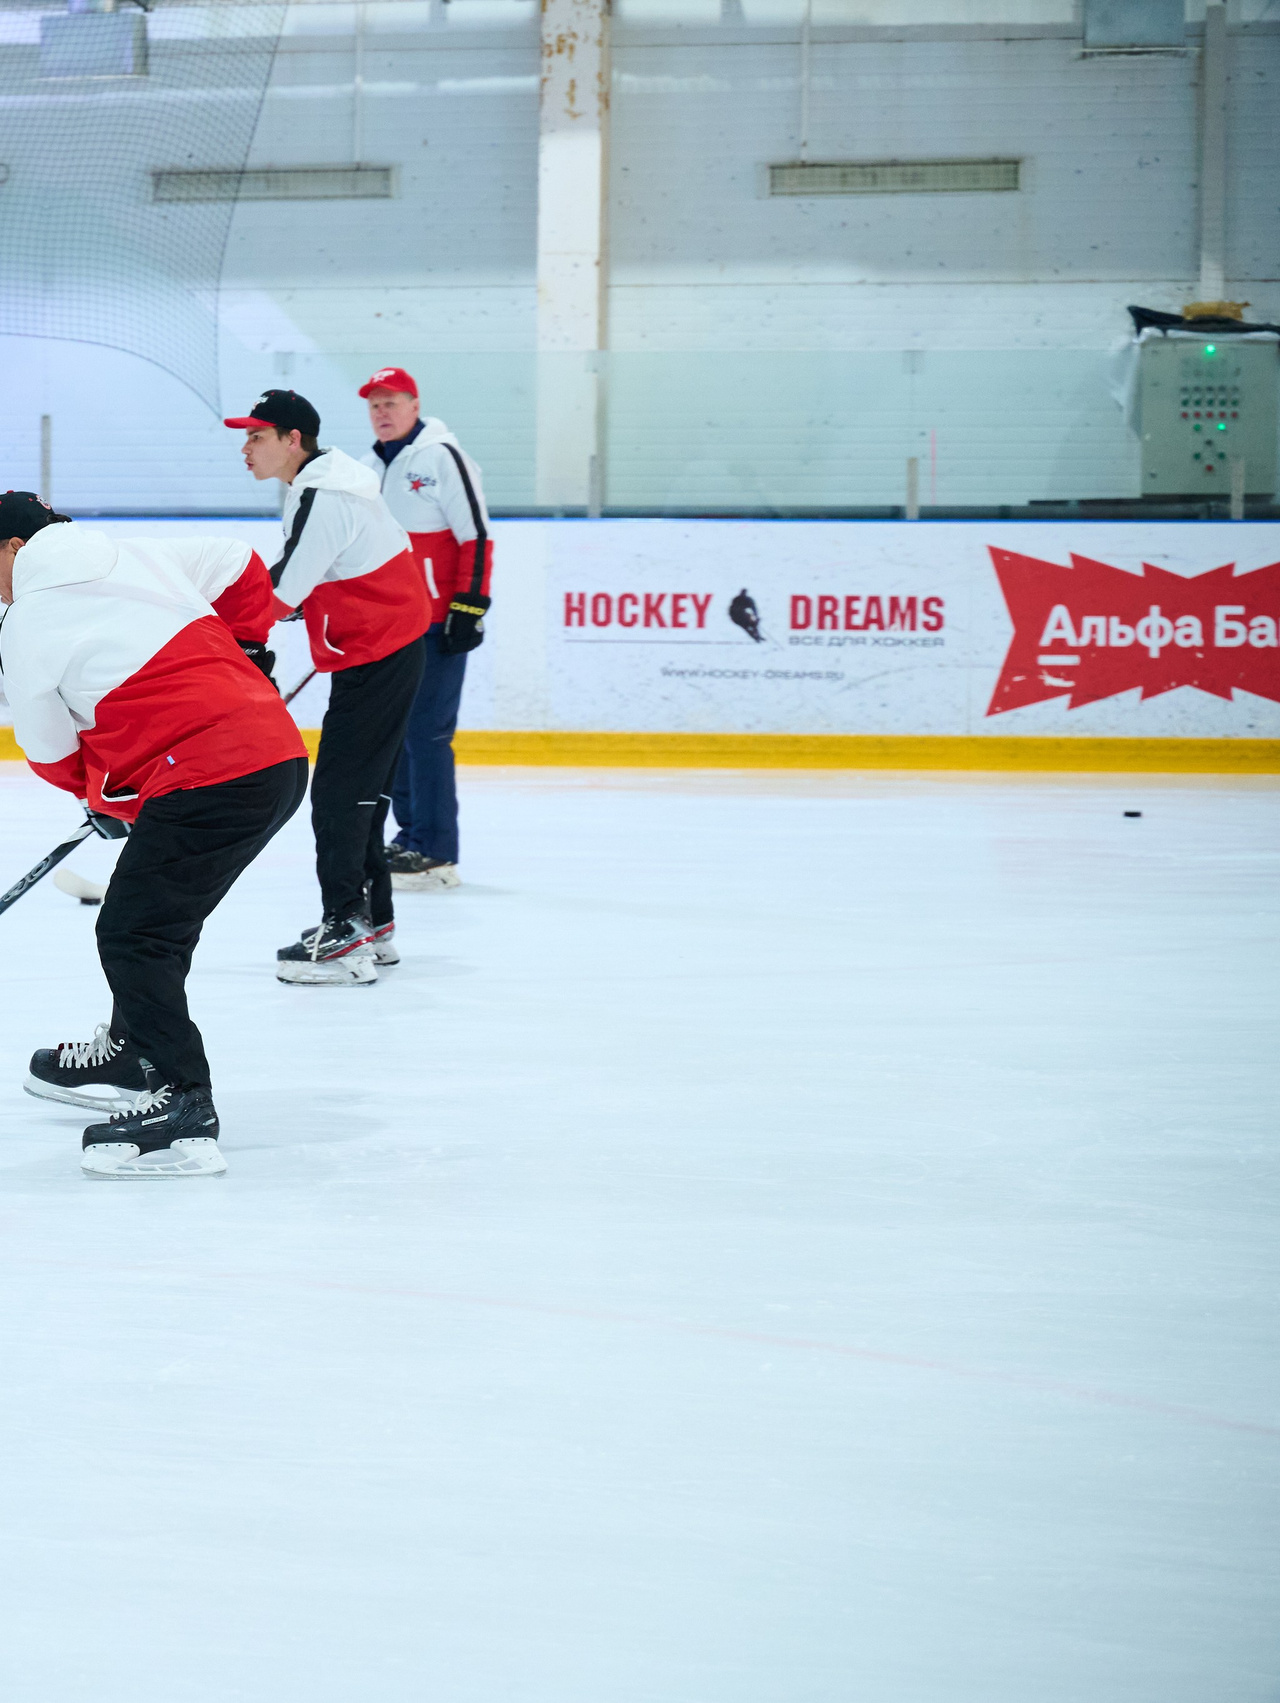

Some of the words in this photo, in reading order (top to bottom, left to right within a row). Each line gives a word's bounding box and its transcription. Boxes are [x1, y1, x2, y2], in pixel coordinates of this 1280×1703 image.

[564, 592, 713, 629] HOCKEY
[790, 594, 945, 632] DREAMS
[1038, 604, 1205, 658] Альфа
[1214, 604, 1280, 648] Ба
[788, 635, 824, 647] ВСЕ
